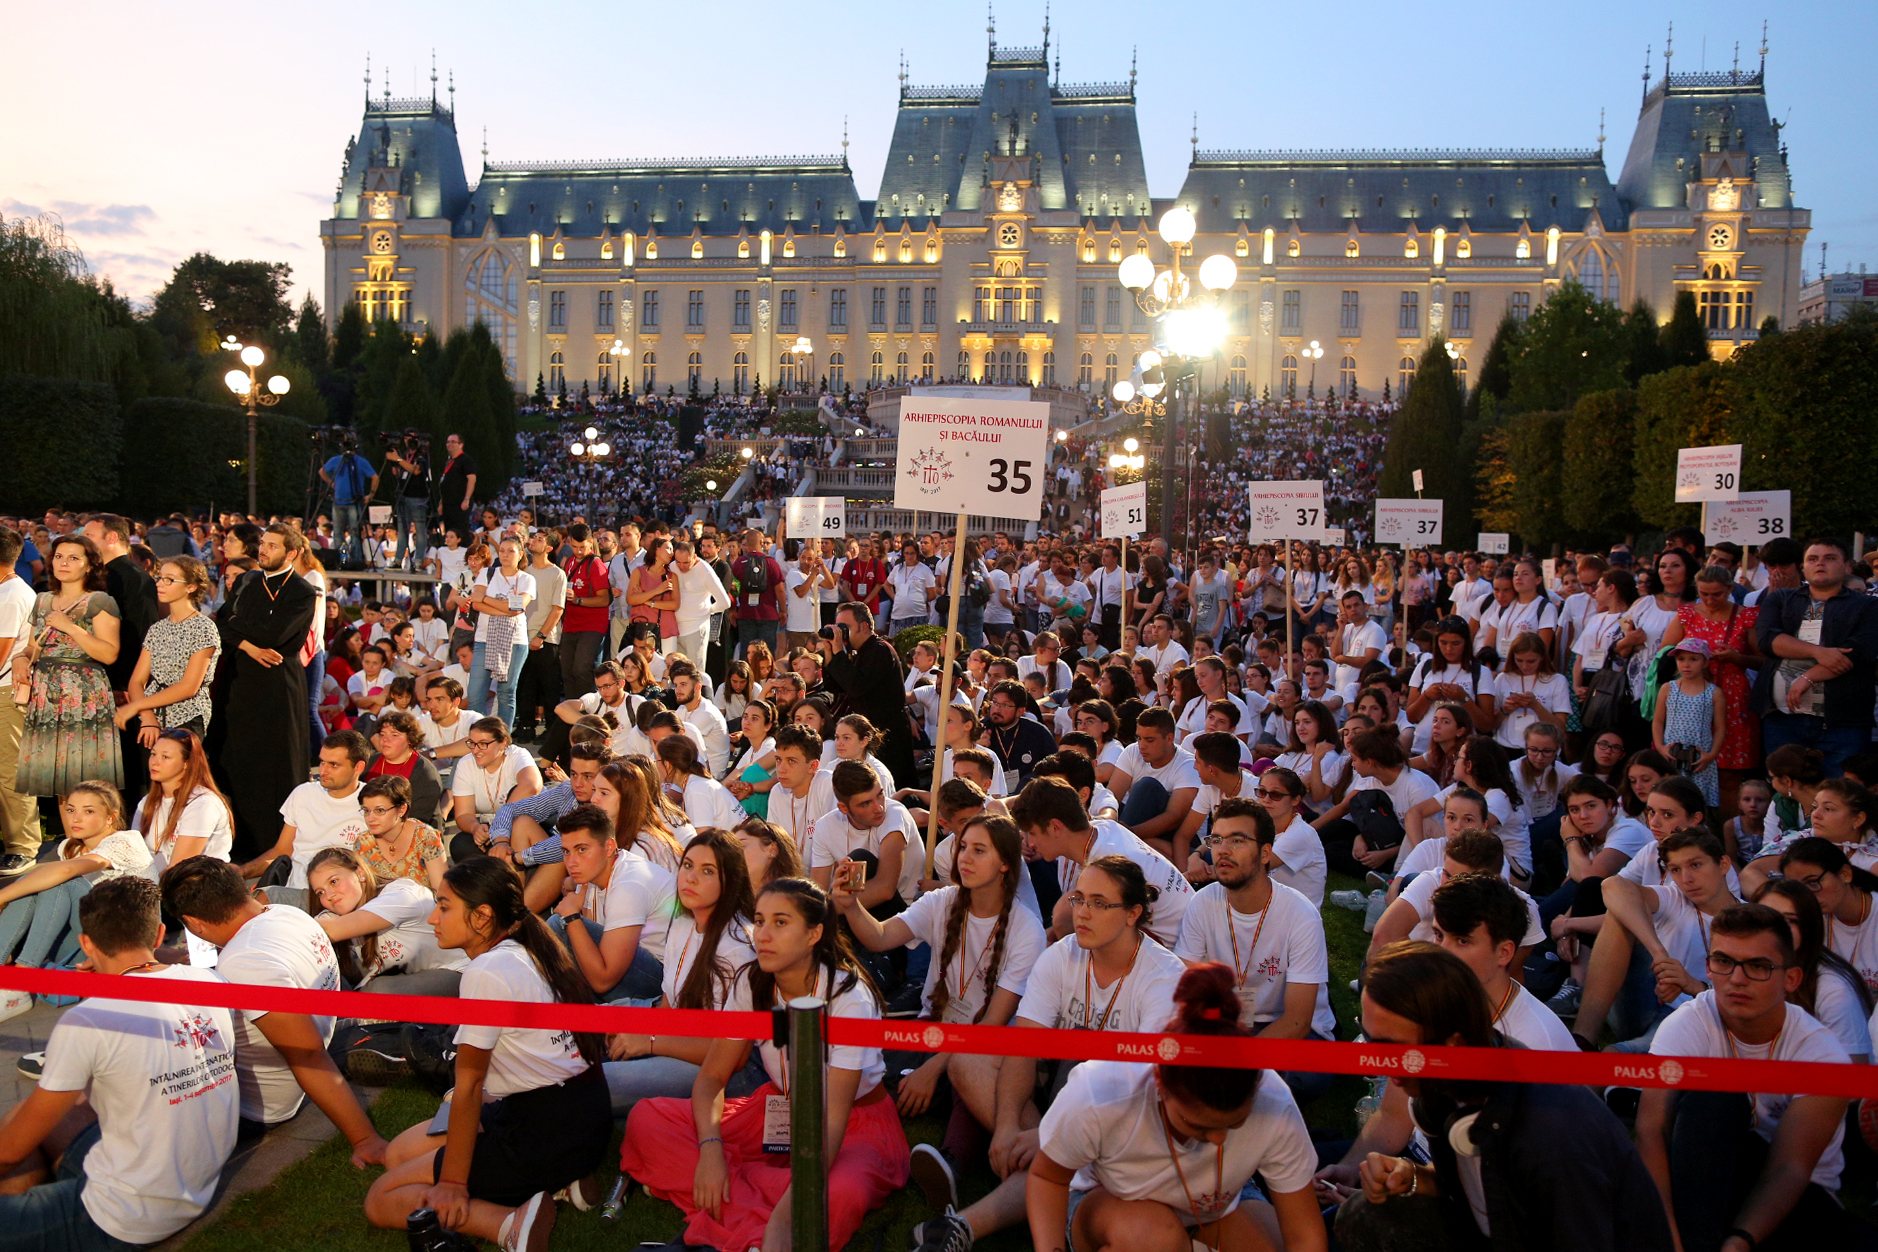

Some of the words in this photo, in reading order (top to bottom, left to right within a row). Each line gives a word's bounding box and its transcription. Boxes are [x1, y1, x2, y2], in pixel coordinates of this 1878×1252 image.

[904, 412, 977, 426] ARHIEPISCOPIA
[980, 416, 1043, 429] ROMANULUI
[939, 430, 948, 442] ȘI
[951, 430, 1002, 443] BACĂULUI
[987, 458, 1032, 495] 35
[1714, 472, 1735, 490] 30
[1128, 507, 1142, 524] 51
[1296, 508, 1319, 526] 37
[822, 516, 841, 530] 49
[1417, 520, 1438, 534] 37
[1757, 517, 1784, 534] 38
[884, 1030, 920, 1043] PALAS
[1117, 1043, 1154, 1056] PALAS
[1360, 1055, 1398, 1068] PALAS
[1614, 1065, 1655, 1079] PALAS
[161, 1087, 168, 1096] A
[168, 1076, 204, 1094] TINERILOR
[218, 1074, 233, 1086] 2017
